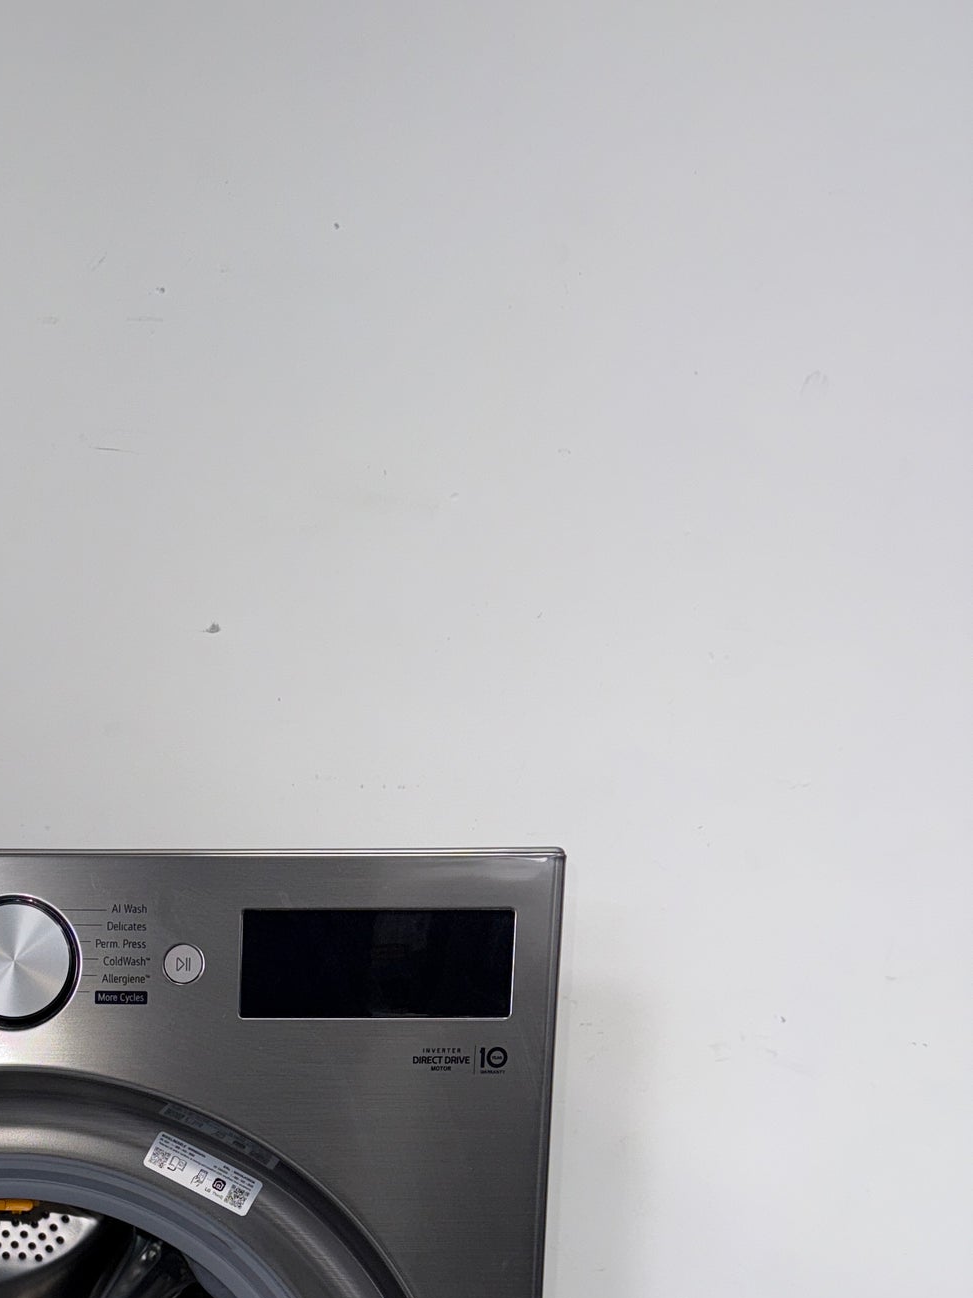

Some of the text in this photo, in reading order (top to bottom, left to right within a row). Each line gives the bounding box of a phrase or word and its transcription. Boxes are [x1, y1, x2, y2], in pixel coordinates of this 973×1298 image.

[111, 904, 147, 914] AI Wash
[107, 921, 147, 931] Delicates
[95, 939, 147, 949] Perm. Press
[97, 993, 145, 1004] More Cycles
[412, 1056, 471, 1064] DIRECT DRIVE
